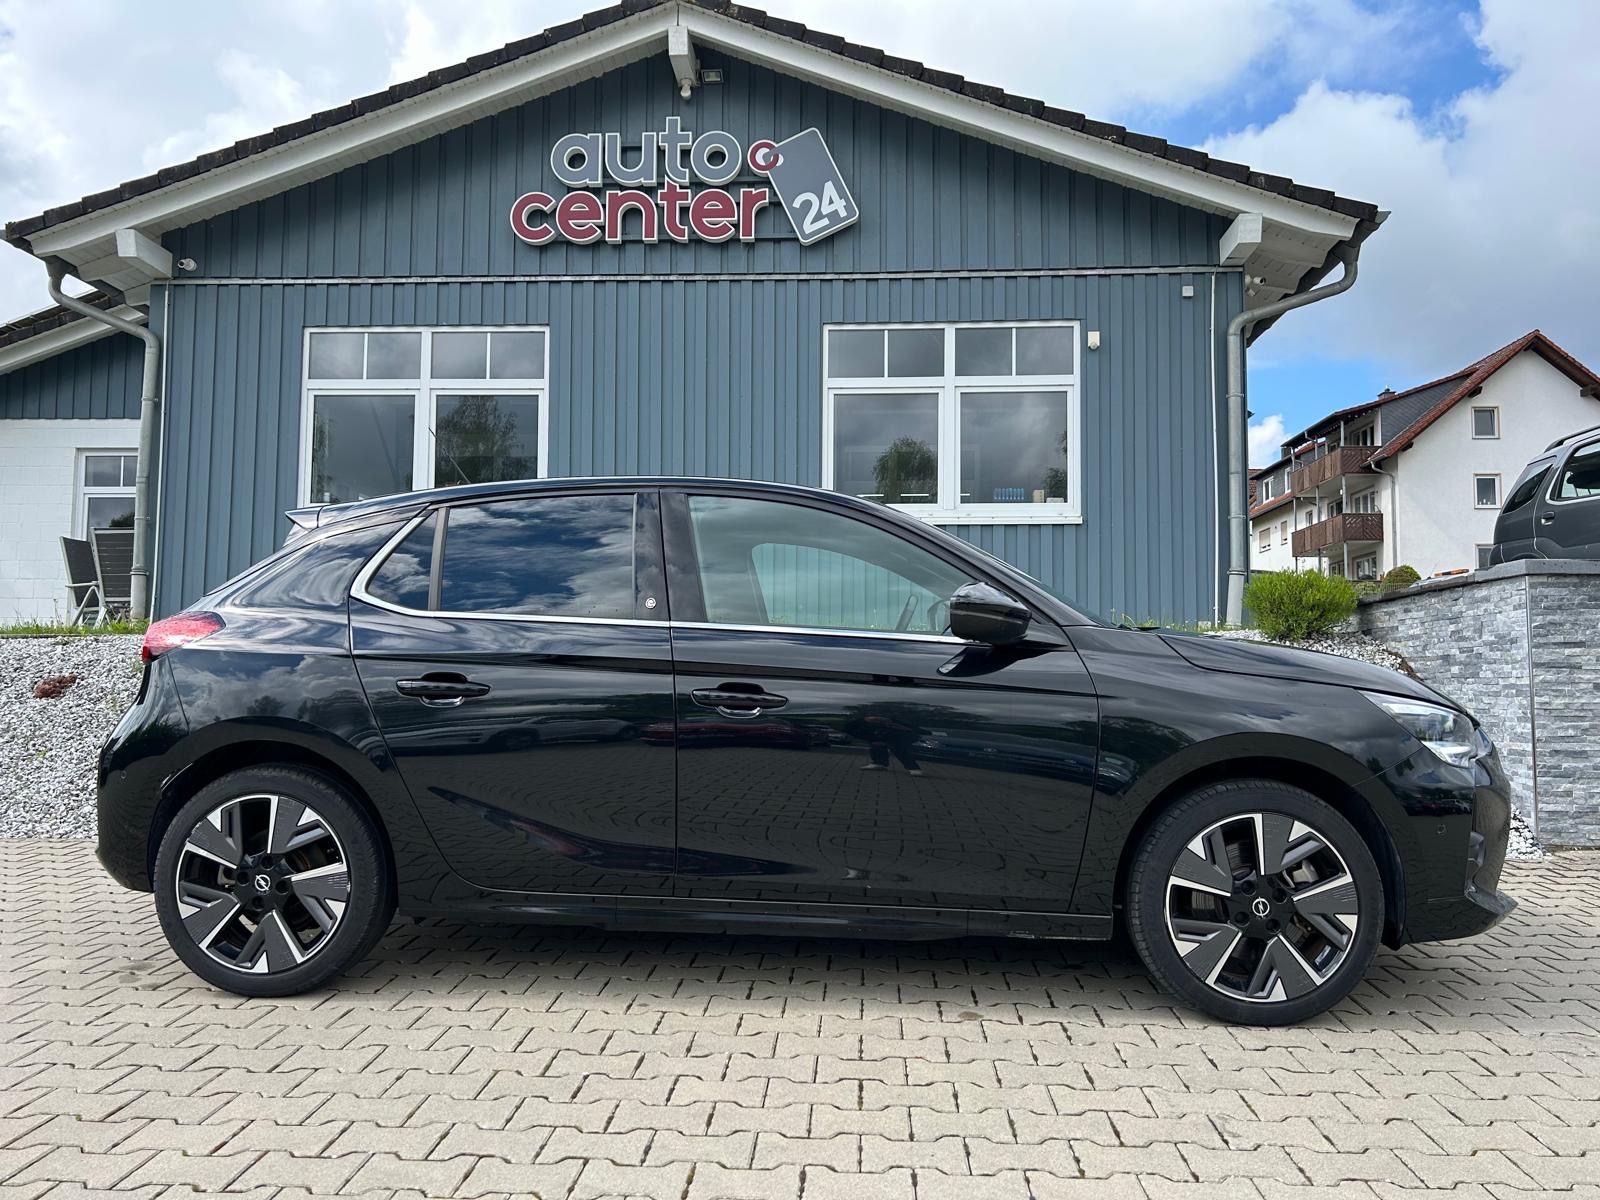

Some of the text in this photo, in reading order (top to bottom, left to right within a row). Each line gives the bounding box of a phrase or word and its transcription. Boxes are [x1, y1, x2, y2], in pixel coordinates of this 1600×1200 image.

[550, 116, 742, 186] auto
[510, 176, 769, 244] center
[792, 180, 847, 234] 24
